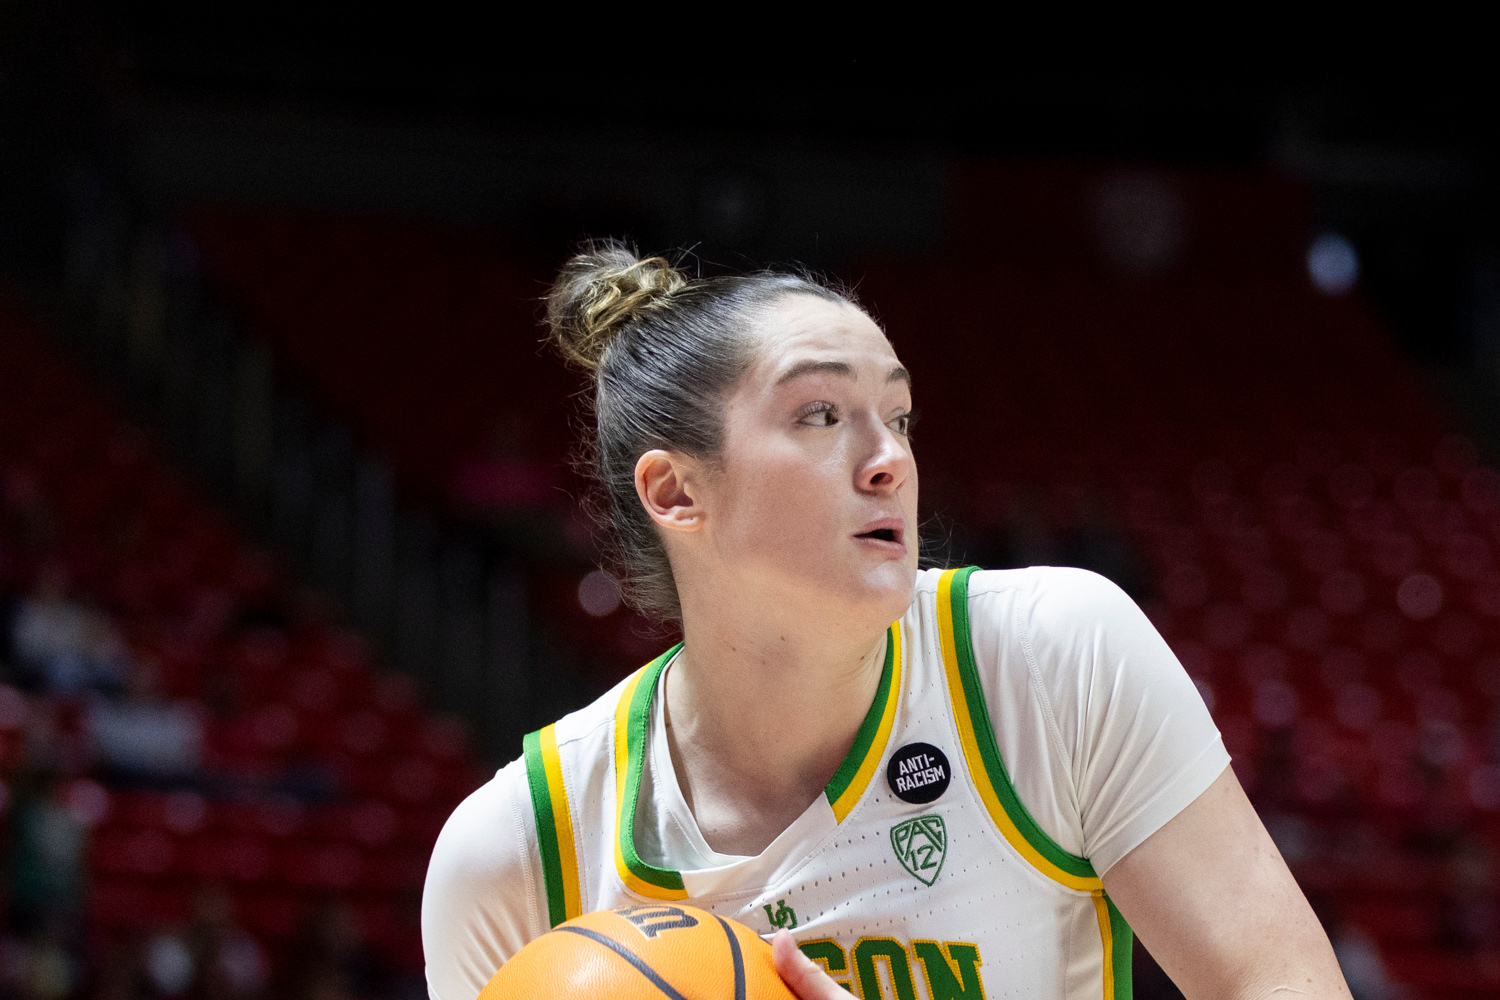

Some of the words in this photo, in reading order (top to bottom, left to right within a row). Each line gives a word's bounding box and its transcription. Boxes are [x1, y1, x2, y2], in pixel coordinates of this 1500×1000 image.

[896, 764, 946, 793] RACISM
[898, 753, 935, 776] ANTI-
[895, 818, 943, 862] PAC
[910, 844, 938, 872] 12
